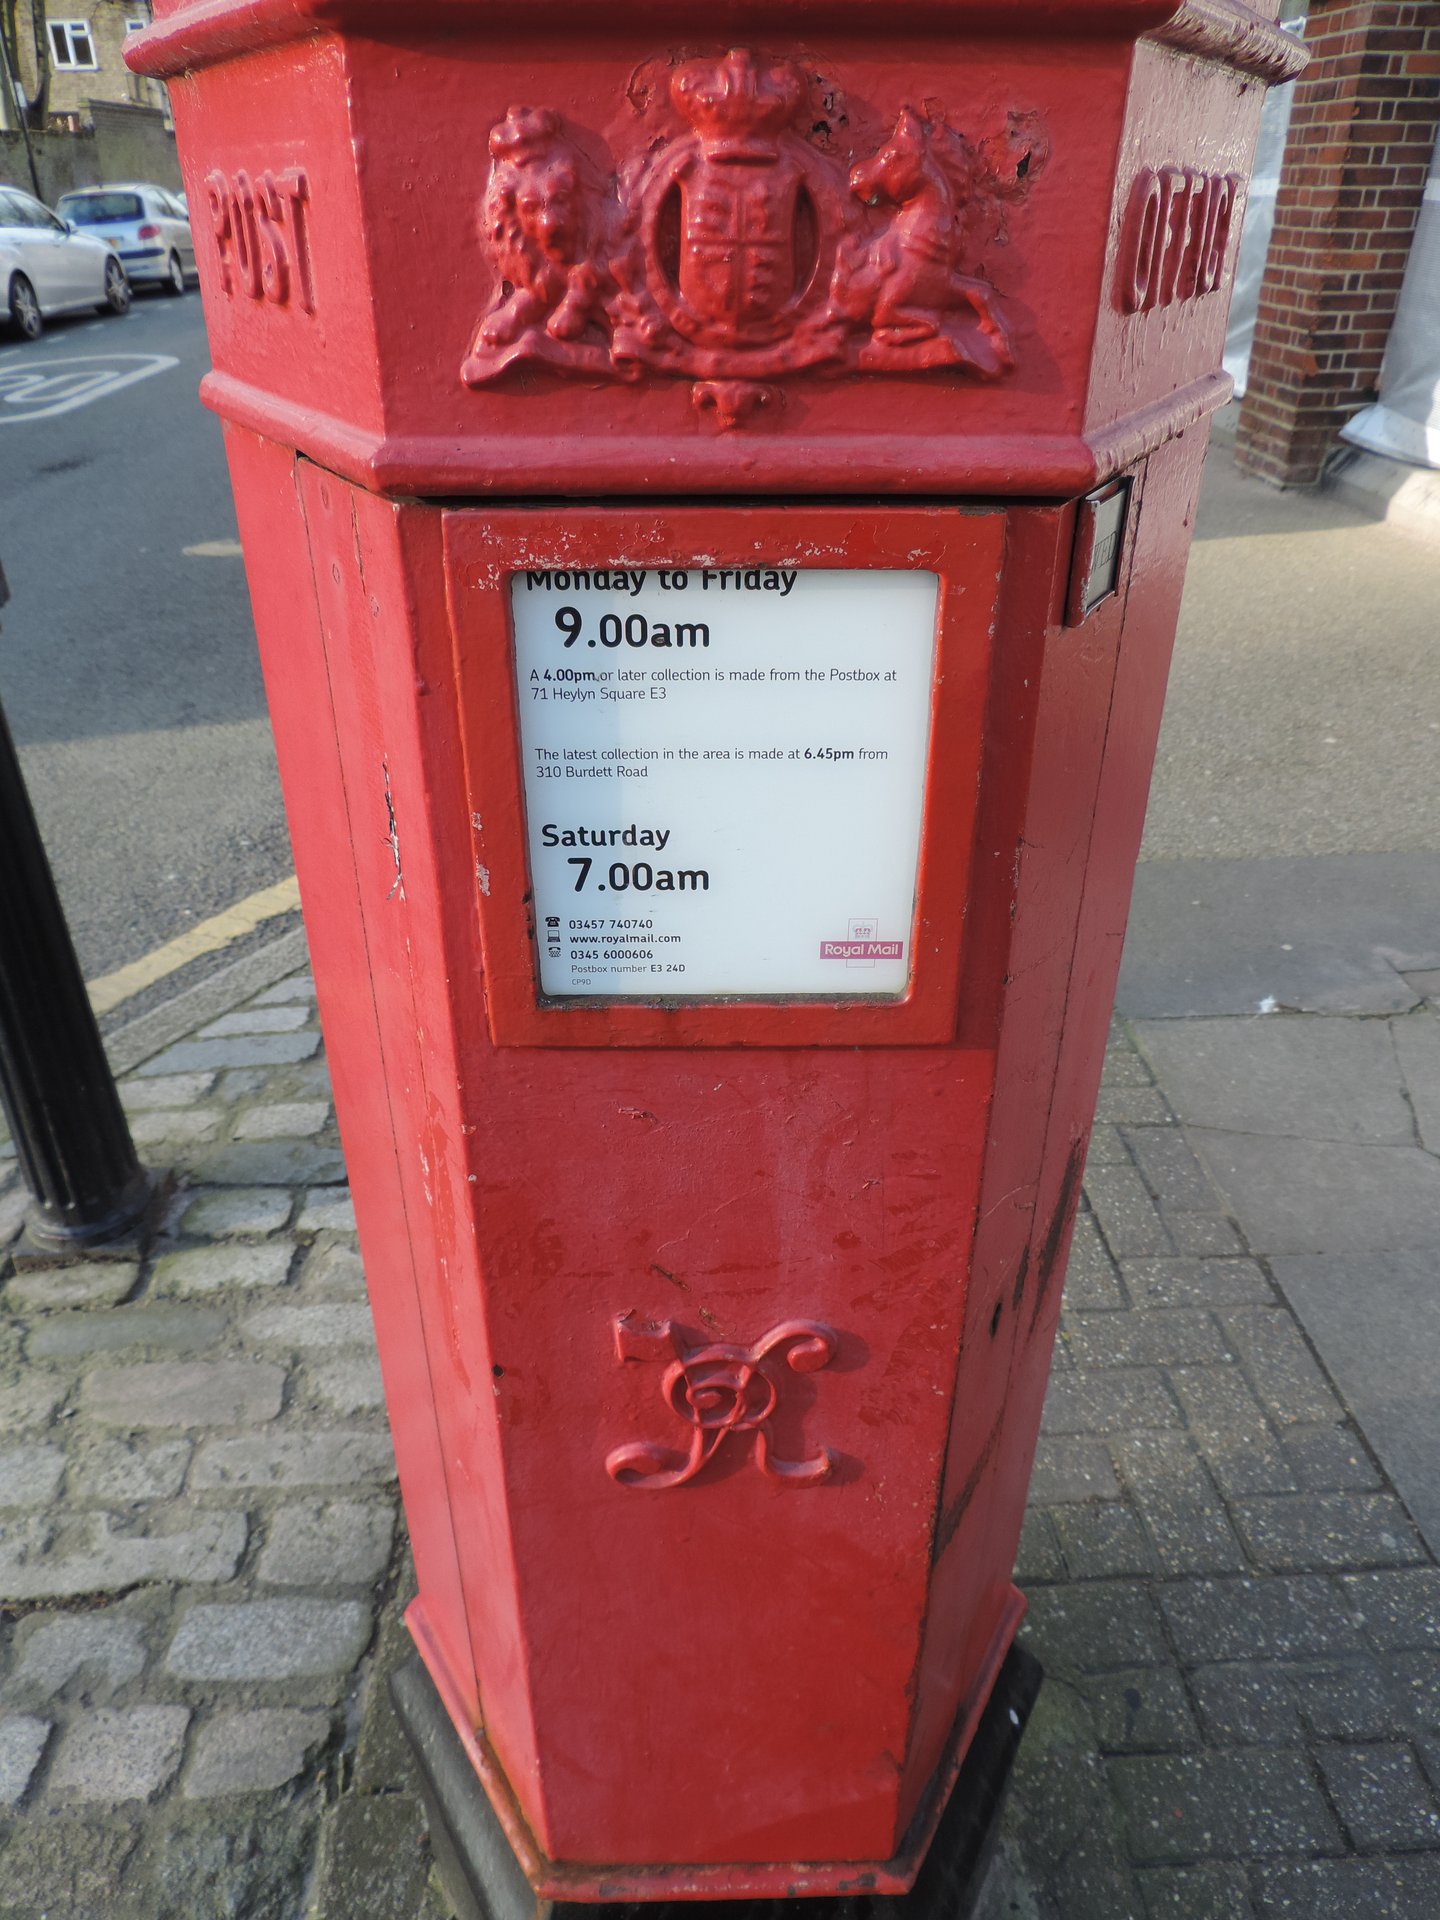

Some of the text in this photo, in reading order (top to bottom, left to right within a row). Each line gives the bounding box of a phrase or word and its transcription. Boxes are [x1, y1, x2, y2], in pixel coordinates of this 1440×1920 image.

[526, 570, 798, 597] Monday to Friday
[554, 605, 710, 649] 9.00am
[529, 668, 540, 682] A
[599, 671, 614, 681] or
[617, 668, 648, 682] later
[650, 667, 711, 682] collection
[714, 667, 725, 681] is
[729, 668, 766, 682] made
[769, 667, 801, 681] from
[804, 668, 826, 681] the
[829, 667, 881, 682] Postbox
[883, 669, 897, 682] at
[530, 686, 667, 703] 71 Heylyn Square E3
[534, 747, 889, 763] The latest collection in the area is made at 6.45pm from
[536, 765, 649, 778] 310 Burdett Road
[541, 824, 671, 851] Saturday
[567, 857, 710, 893] 7.00am
[568, 918, 653, 930] 03457 740740
[569, 933, 682, 945] www.royalmail.com
[570, 949, 654, 960] 0345 6000606
[824, 943, 899, 957] Royal Mail
[571, 964, 608, 973] Postbox
[610, 964, 648, 973] number
[650, 964, 663, 973] E3
